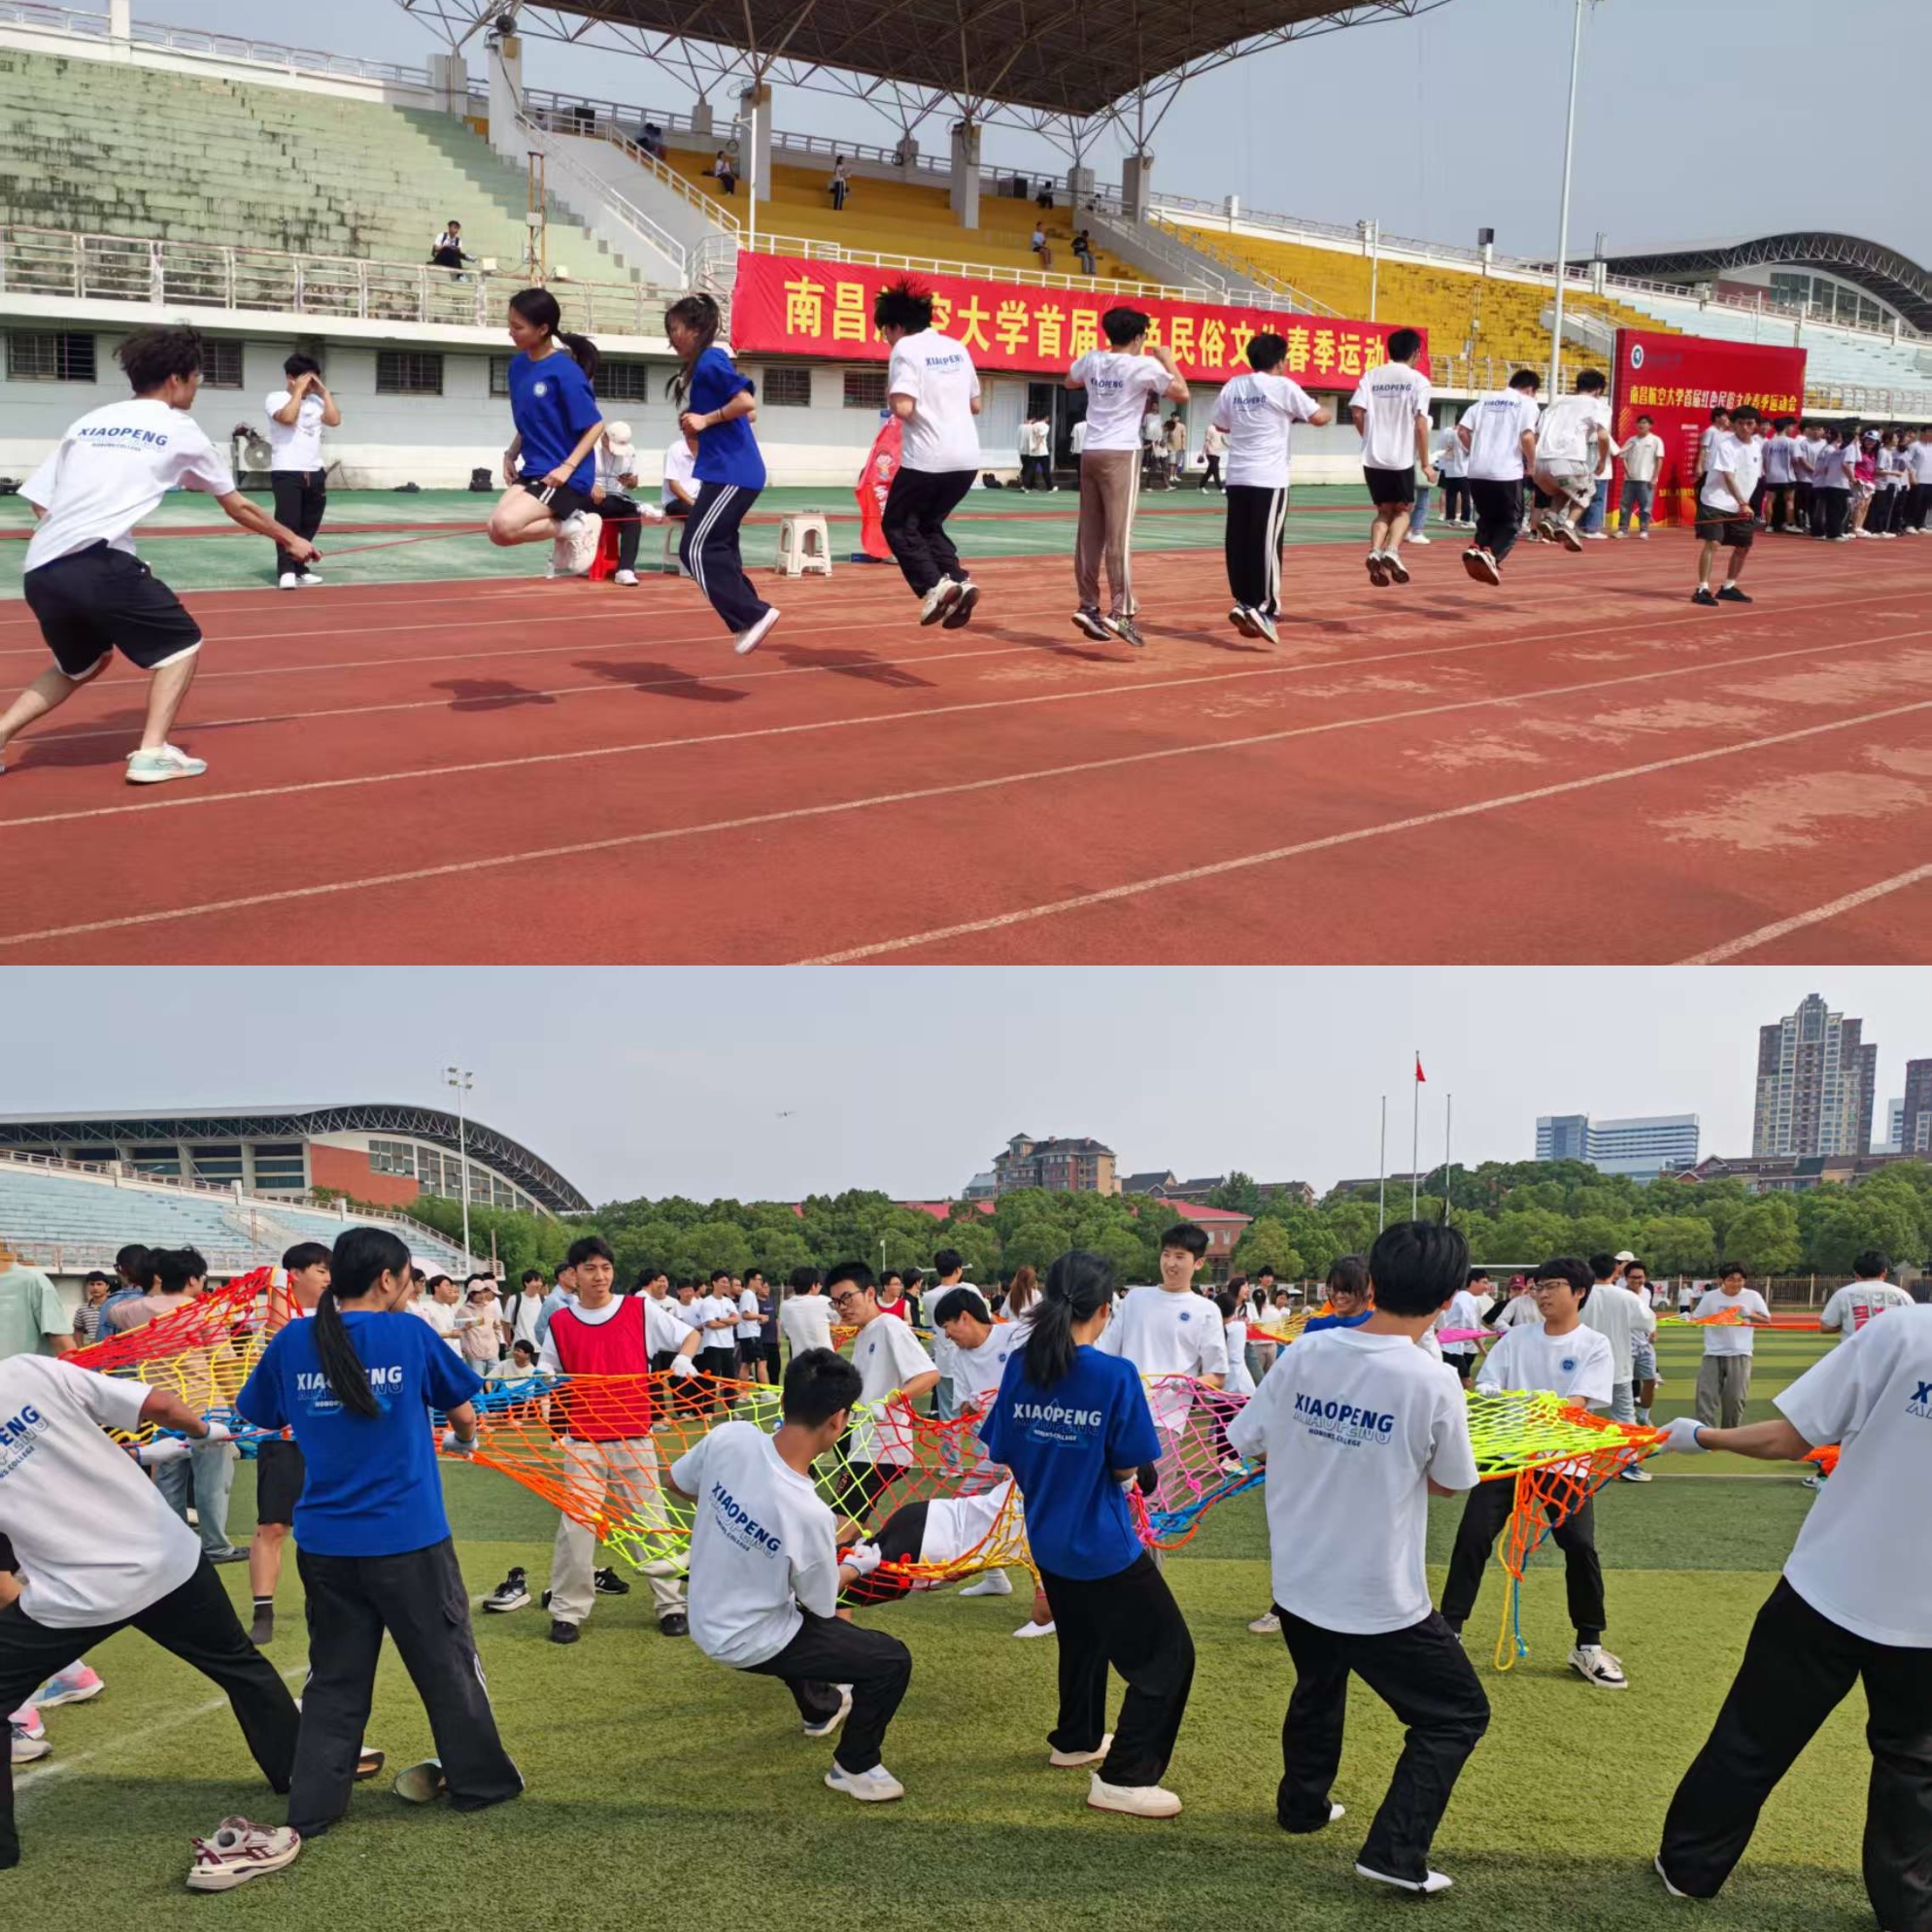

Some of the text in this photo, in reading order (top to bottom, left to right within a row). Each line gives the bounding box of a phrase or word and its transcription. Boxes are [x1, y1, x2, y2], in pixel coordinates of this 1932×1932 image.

[784, 277, 1385, 376] 南昌大学首届色民俗文春季运动
[78, 427, 169, 446] XIAOPENG
[297, 1366, 402, 1391] XIANG
[1013, 1403, 1102, 1427] XIAOPENG
[1295, 1392, 1395, 1433] XIAOPENG
[8, 1445, 35, 1471] COLLEGE
[712, 1480, 781, 1551] XIAOPENG
